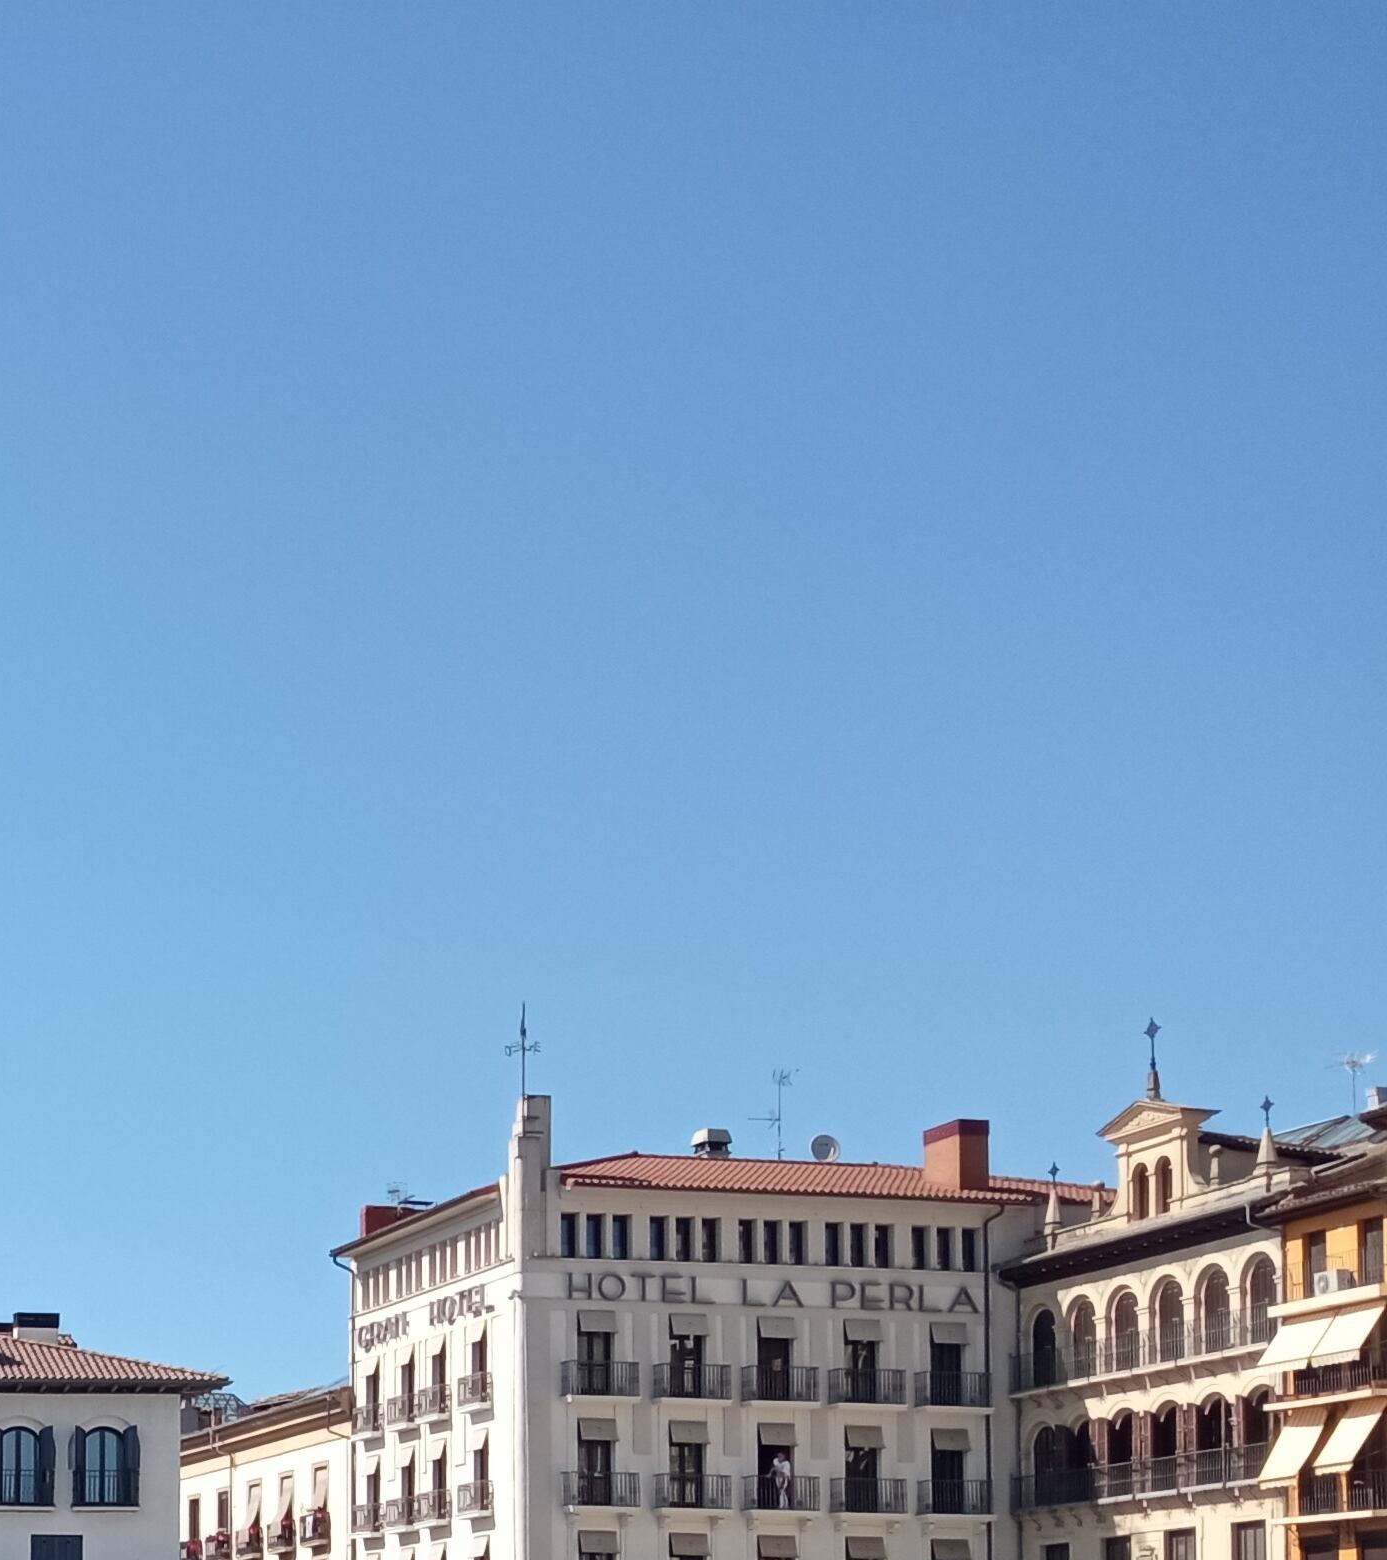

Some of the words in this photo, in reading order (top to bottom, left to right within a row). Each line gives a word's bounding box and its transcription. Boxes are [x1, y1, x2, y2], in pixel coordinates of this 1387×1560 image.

[357, 1310, 410, 1353] GRAN
[428, 1283, 496, 1327] HOTEL
[566, 1271, 717, 1305] HOTEL
[741, 1277, 805, 1309] LA
[830, 1279, 981, 1315] PERLA
